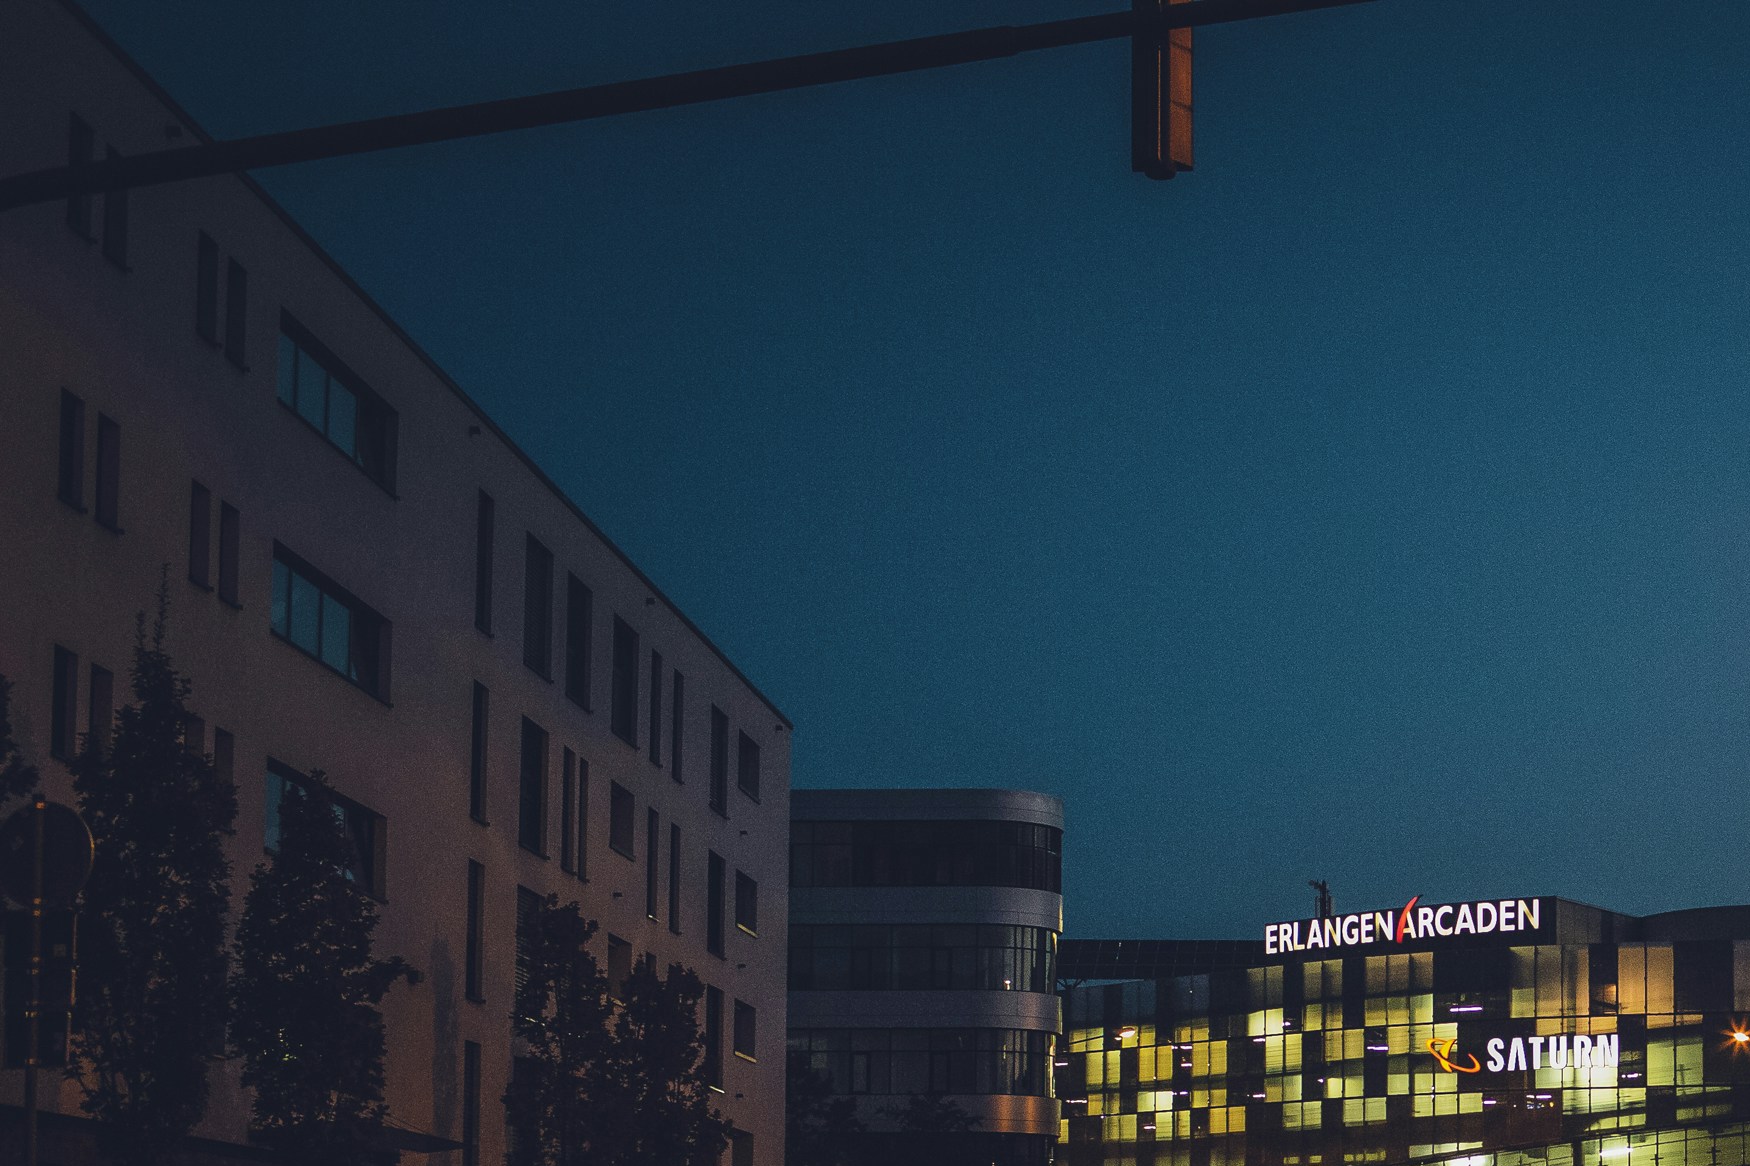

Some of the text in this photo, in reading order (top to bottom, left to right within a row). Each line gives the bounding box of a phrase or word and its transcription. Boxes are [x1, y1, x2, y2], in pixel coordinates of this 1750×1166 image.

[1265, 895, 1541, 955] ERLANGEN ARCADEN
[1486, 1033, 1619, 1073] SATURN
